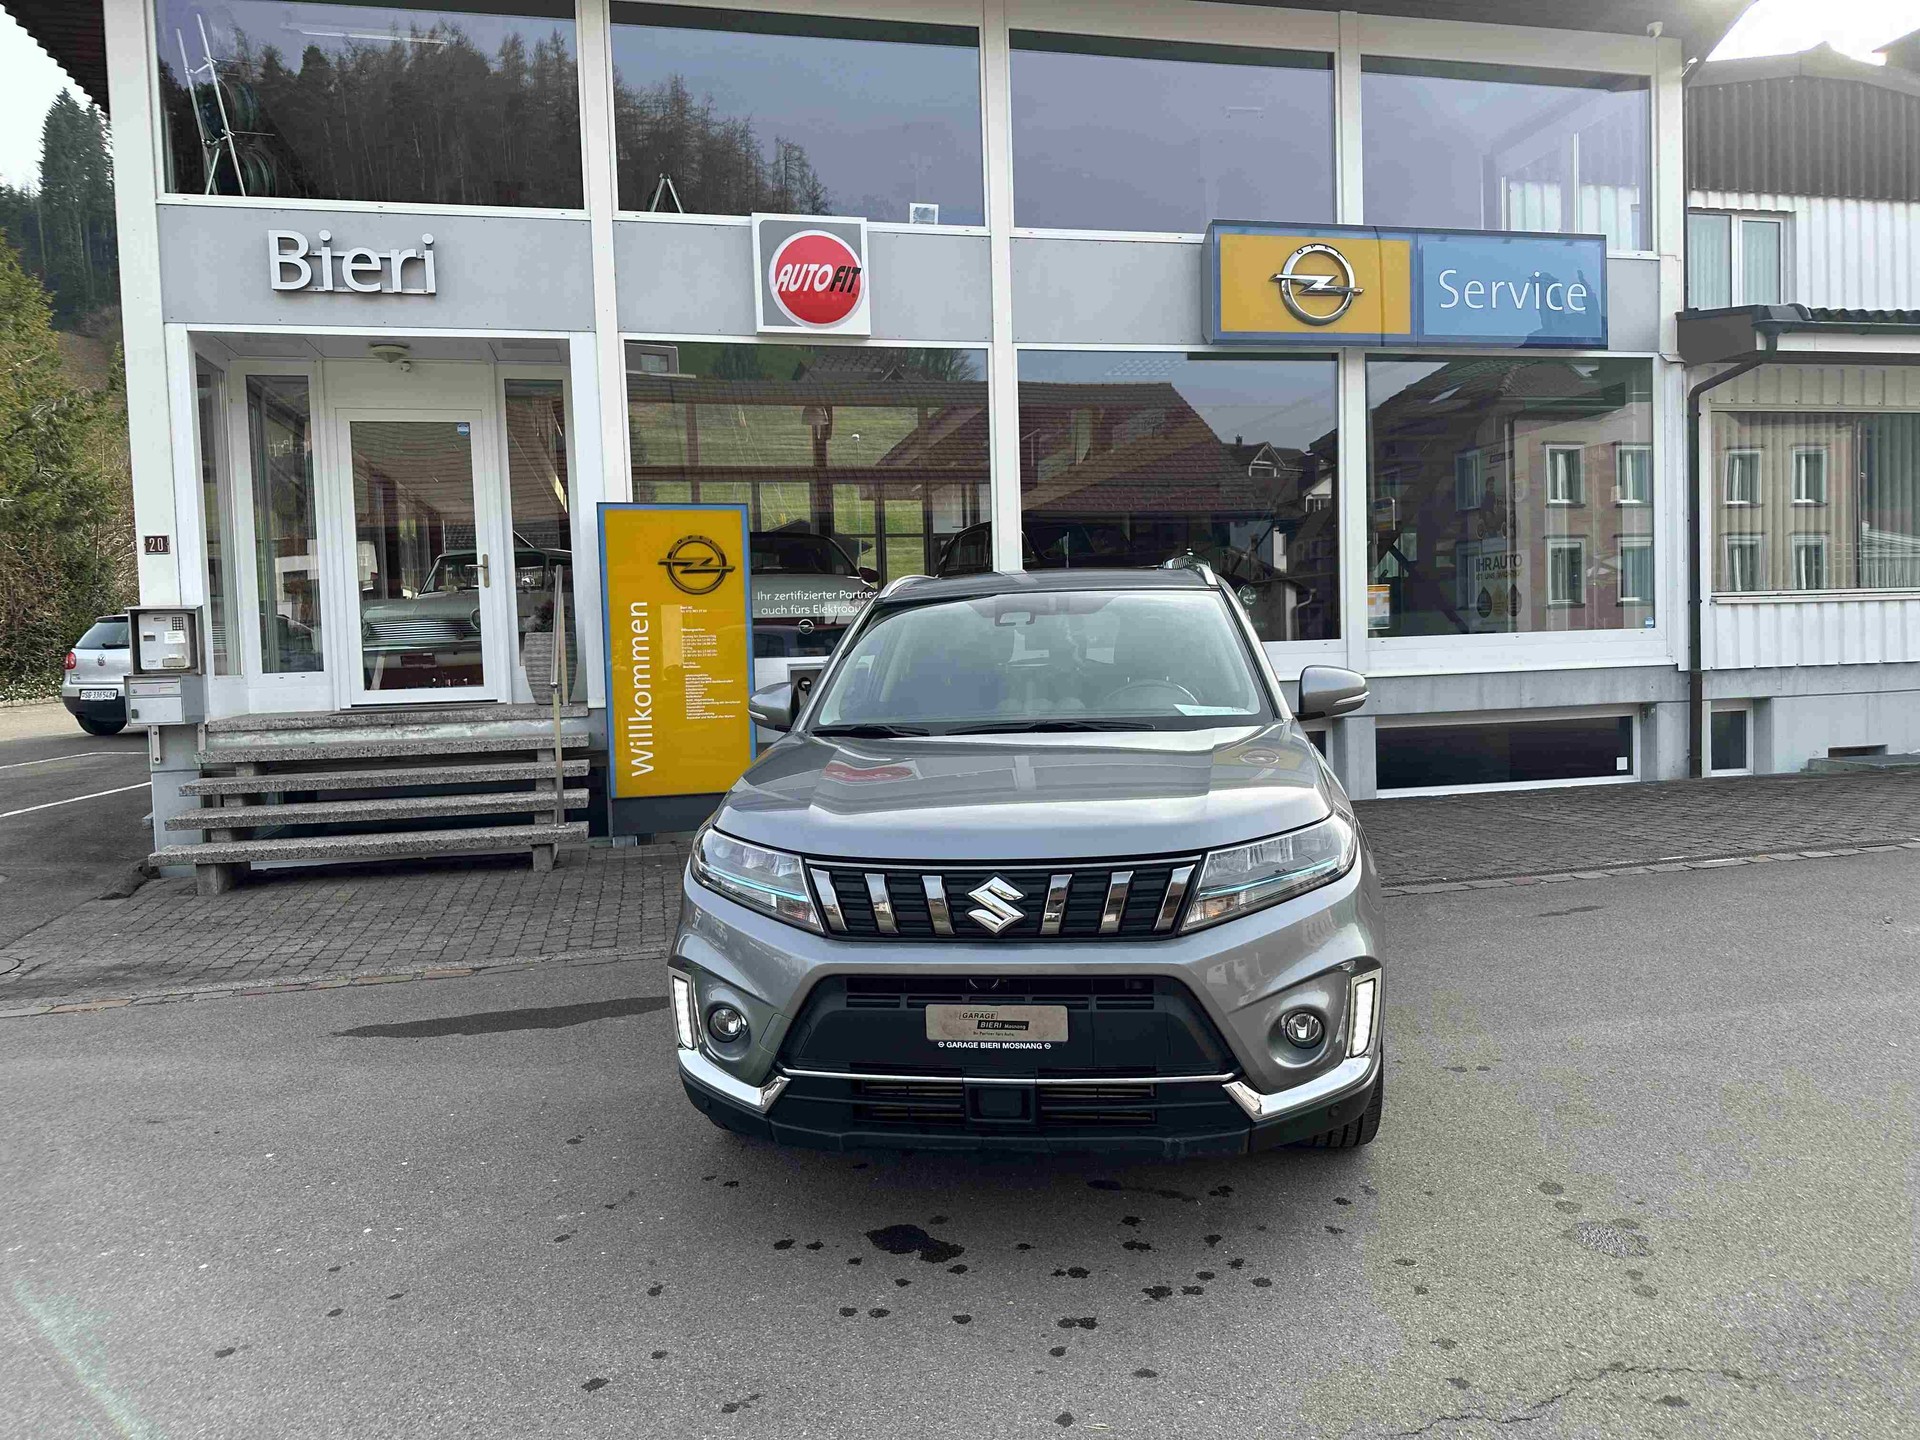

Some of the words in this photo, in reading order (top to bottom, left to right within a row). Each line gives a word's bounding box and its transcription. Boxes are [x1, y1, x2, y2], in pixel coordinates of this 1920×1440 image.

[1296, 243, 1342, 256] OPEL
[268, 229, 436, 294] Bieri
[1438, 269, 1587, 311] Service
[149, 537, 164, 552] 20
[677, 534, 713, 545] OPEL
[1476, 557, 1491, 572] IHR
[1493, 553, 1523, 570] AUTO
[757, 591, 772, 601] Ihr
[774, 590, 837, 601] zertifizierter
[761, 605, 788, 615] auch
[790, 605, 810, 615] fürs
[627, 601, 655, 777] Willkommen
[962, 1012, 996, 1020] GARAGE
[980, 1021, 1002, 1029] BIERI
[946, 1041, 979, 1049] GARAGE
[980, 1041, 1001, 1049] BIERI
[1002, 1042, 1043, 1050] MOSNANG
